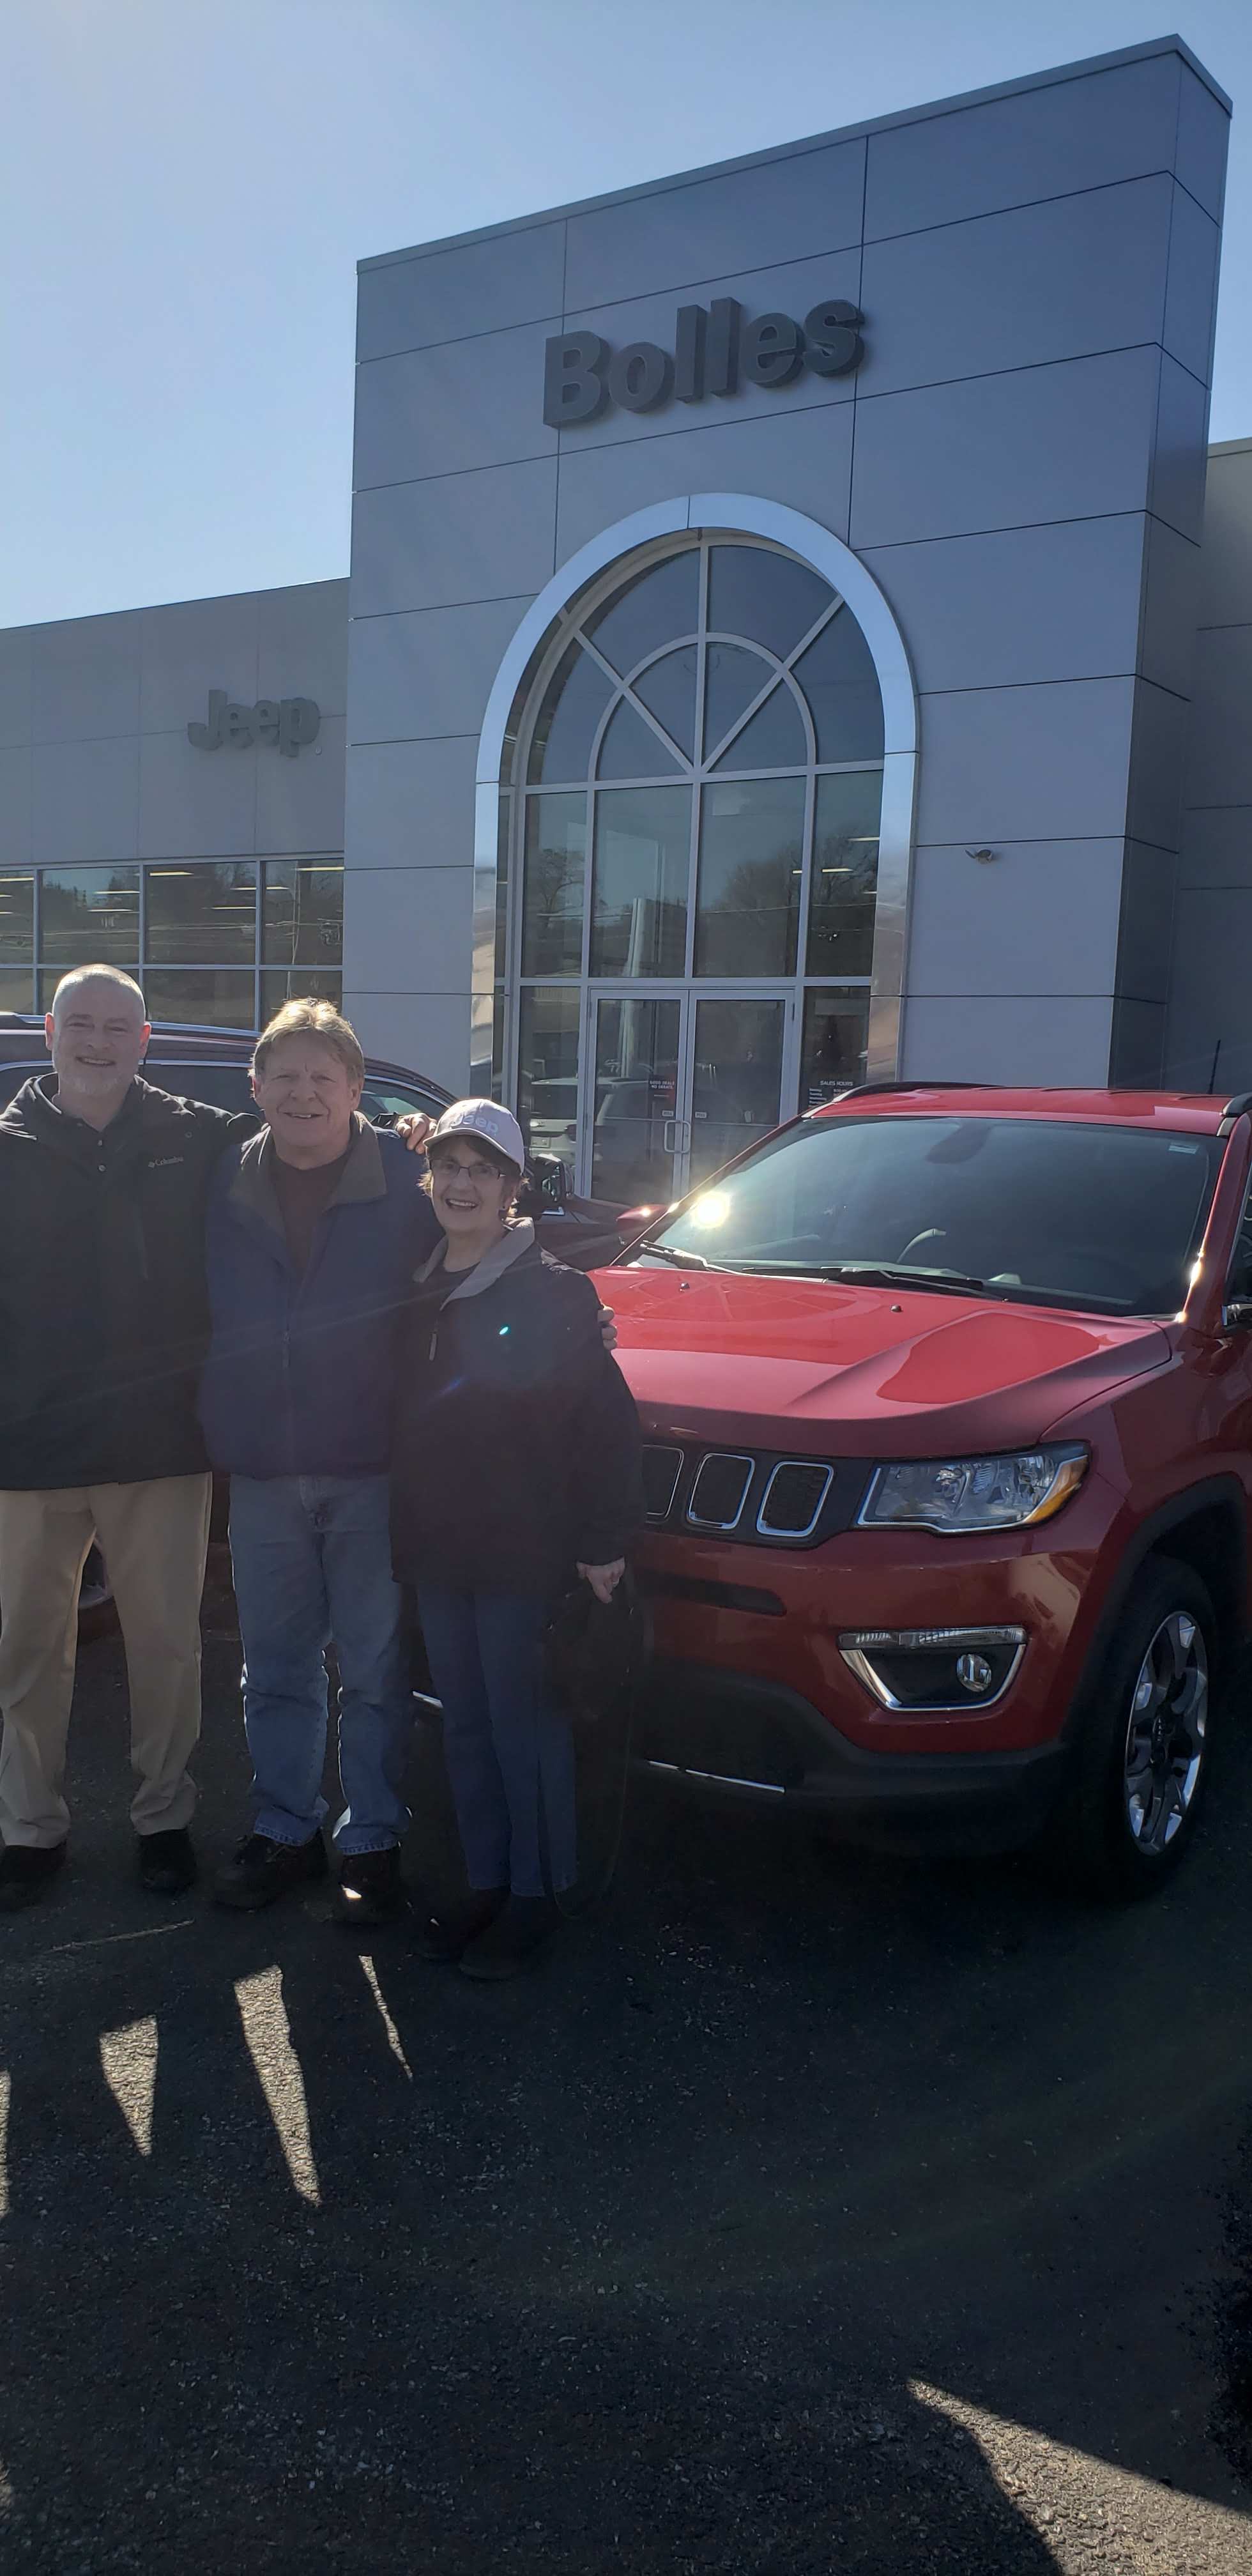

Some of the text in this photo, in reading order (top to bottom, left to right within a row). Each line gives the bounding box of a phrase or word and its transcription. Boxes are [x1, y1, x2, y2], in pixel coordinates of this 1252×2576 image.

[543, 296, 865, 429] Bolles
[187, 689, 321, 758] Jeep
[449, 1114, 499, 1135] Jeep
